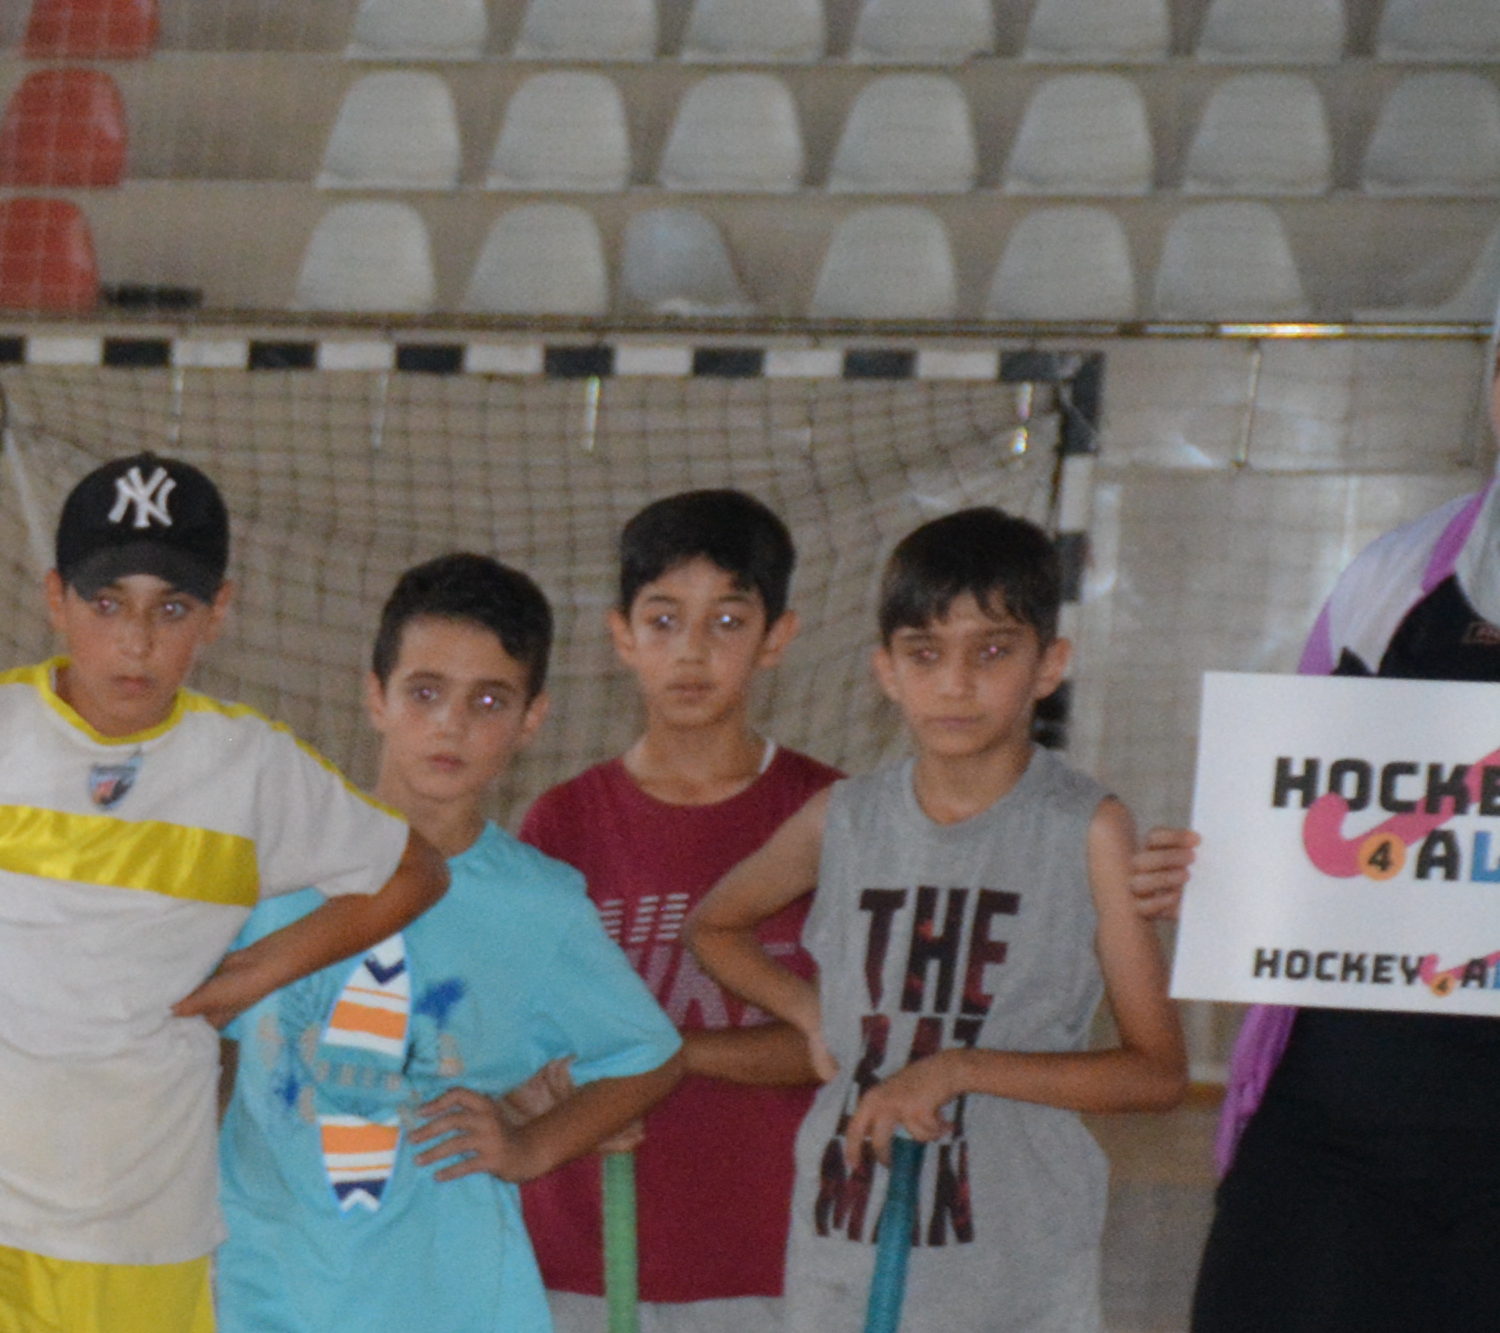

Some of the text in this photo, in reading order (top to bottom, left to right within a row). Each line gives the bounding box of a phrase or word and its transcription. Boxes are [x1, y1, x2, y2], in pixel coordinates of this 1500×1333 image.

[107, 465, 177, 529] NY
[859, 885, 1021, 1015] THE
[1253, 947, 1424, 986] HOCKEY
[815, 1137, 974, 1247] MN
